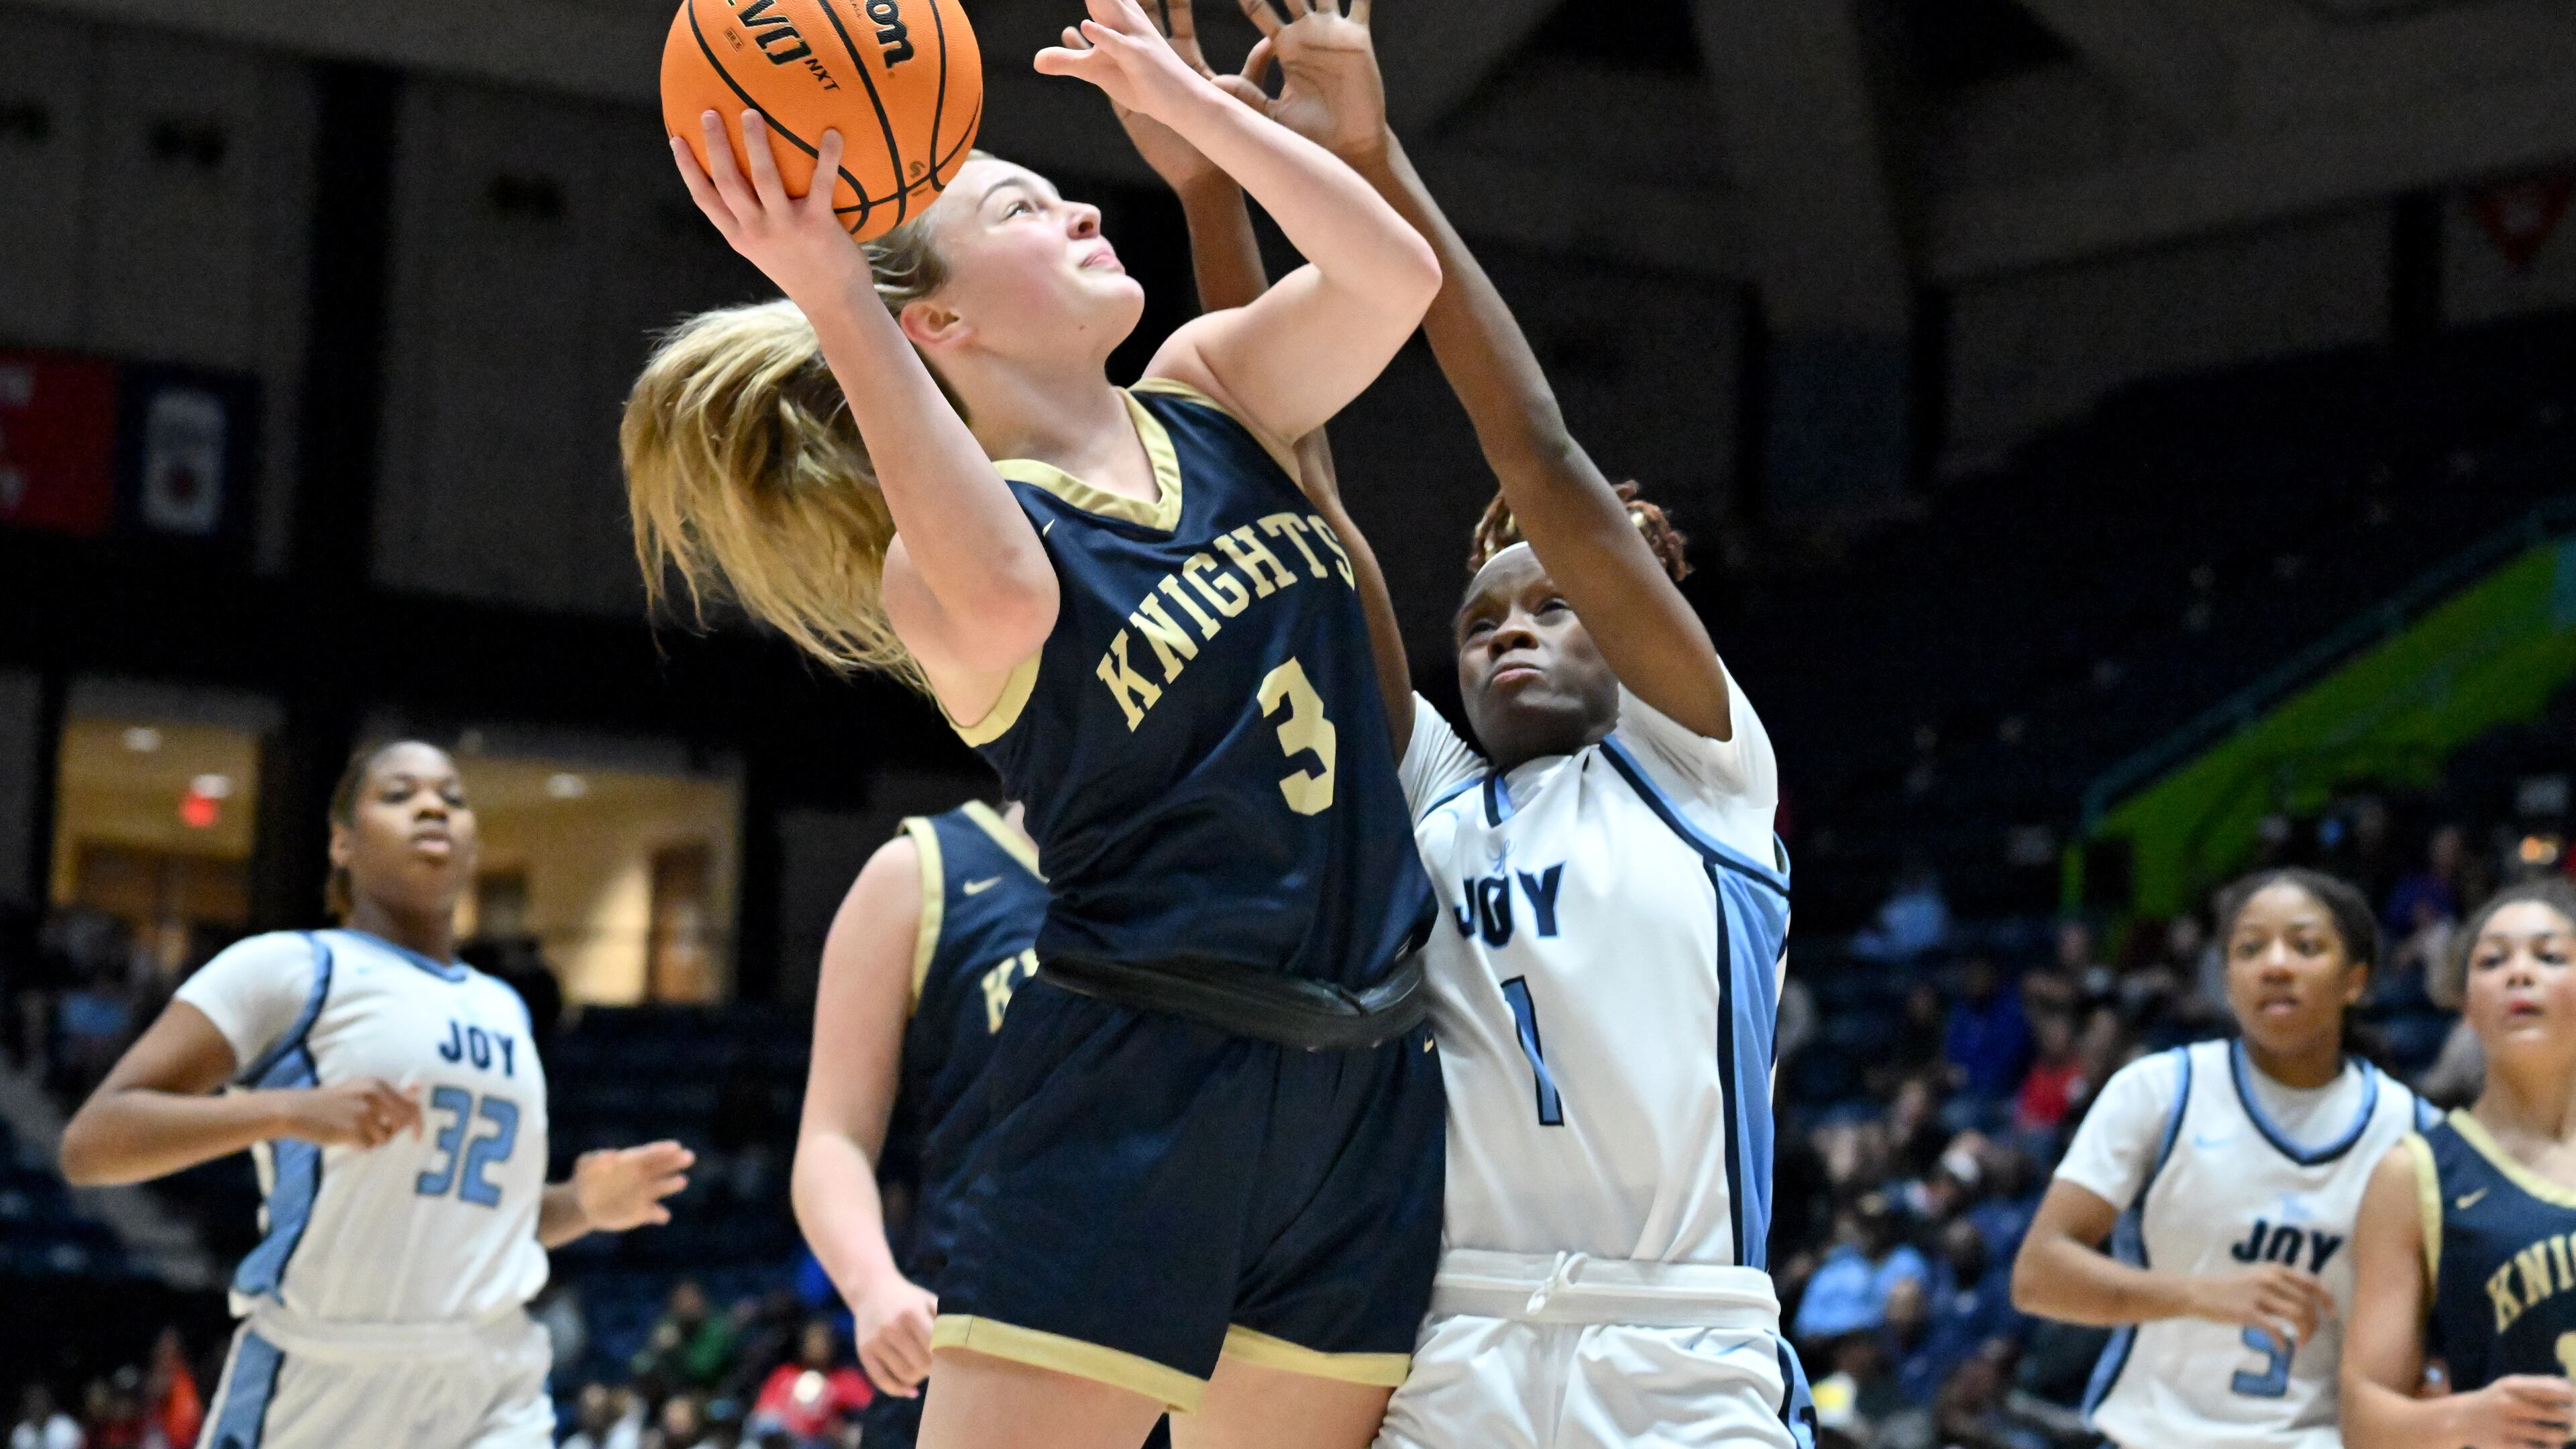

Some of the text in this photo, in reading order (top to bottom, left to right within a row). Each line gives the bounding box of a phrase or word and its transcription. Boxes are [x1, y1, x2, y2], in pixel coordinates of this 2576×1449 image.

[728, 0, 812, 65] VO
[804, 58, 840, 91] NXT
[1095, 512, 1356, 733] KNIGHTS
[1256, 655, 1336, 816] 3
[1452, 859, 1567, 950] JOY
[438, 1018, 515, 1077] JOY
[1500, 975, 1565, 1127] 1
[414, 1083, 521, 1210] 32
[2231, 1217, 2346, 1275] JOY
[2485, 1230, 2576, 1334] KNI
